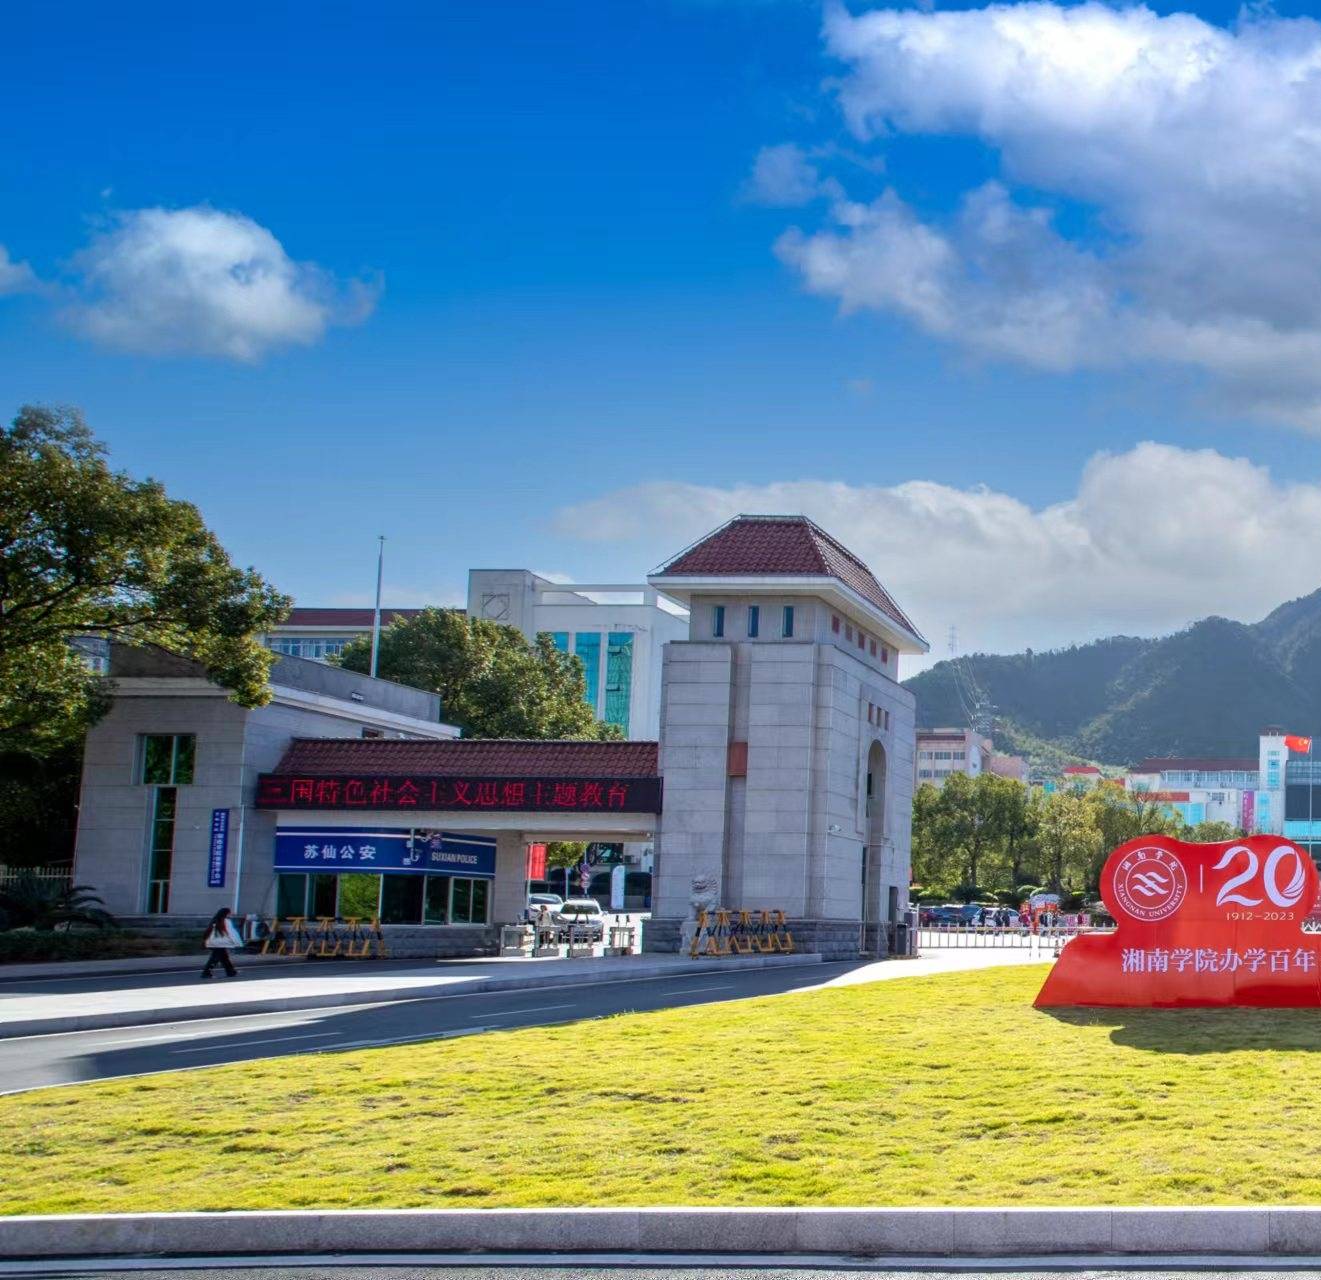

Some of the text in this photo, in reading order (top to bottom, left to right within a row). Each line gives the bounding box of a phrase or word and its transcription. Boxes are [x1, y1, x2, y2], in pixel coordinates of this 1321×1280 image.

[304, 845, 377, 861] 苏仙公安
[431, 851, 478, 865] SUXIAN POLICE
[1211, 845, 1306, 908] 20
[1118, 883, 1183, 917] XIANGNAN UNIVERSITY
[1226, 912, 1295, 921] 1912-2023
[1122, 948, 1316, 973] 湘南学院办学百年
